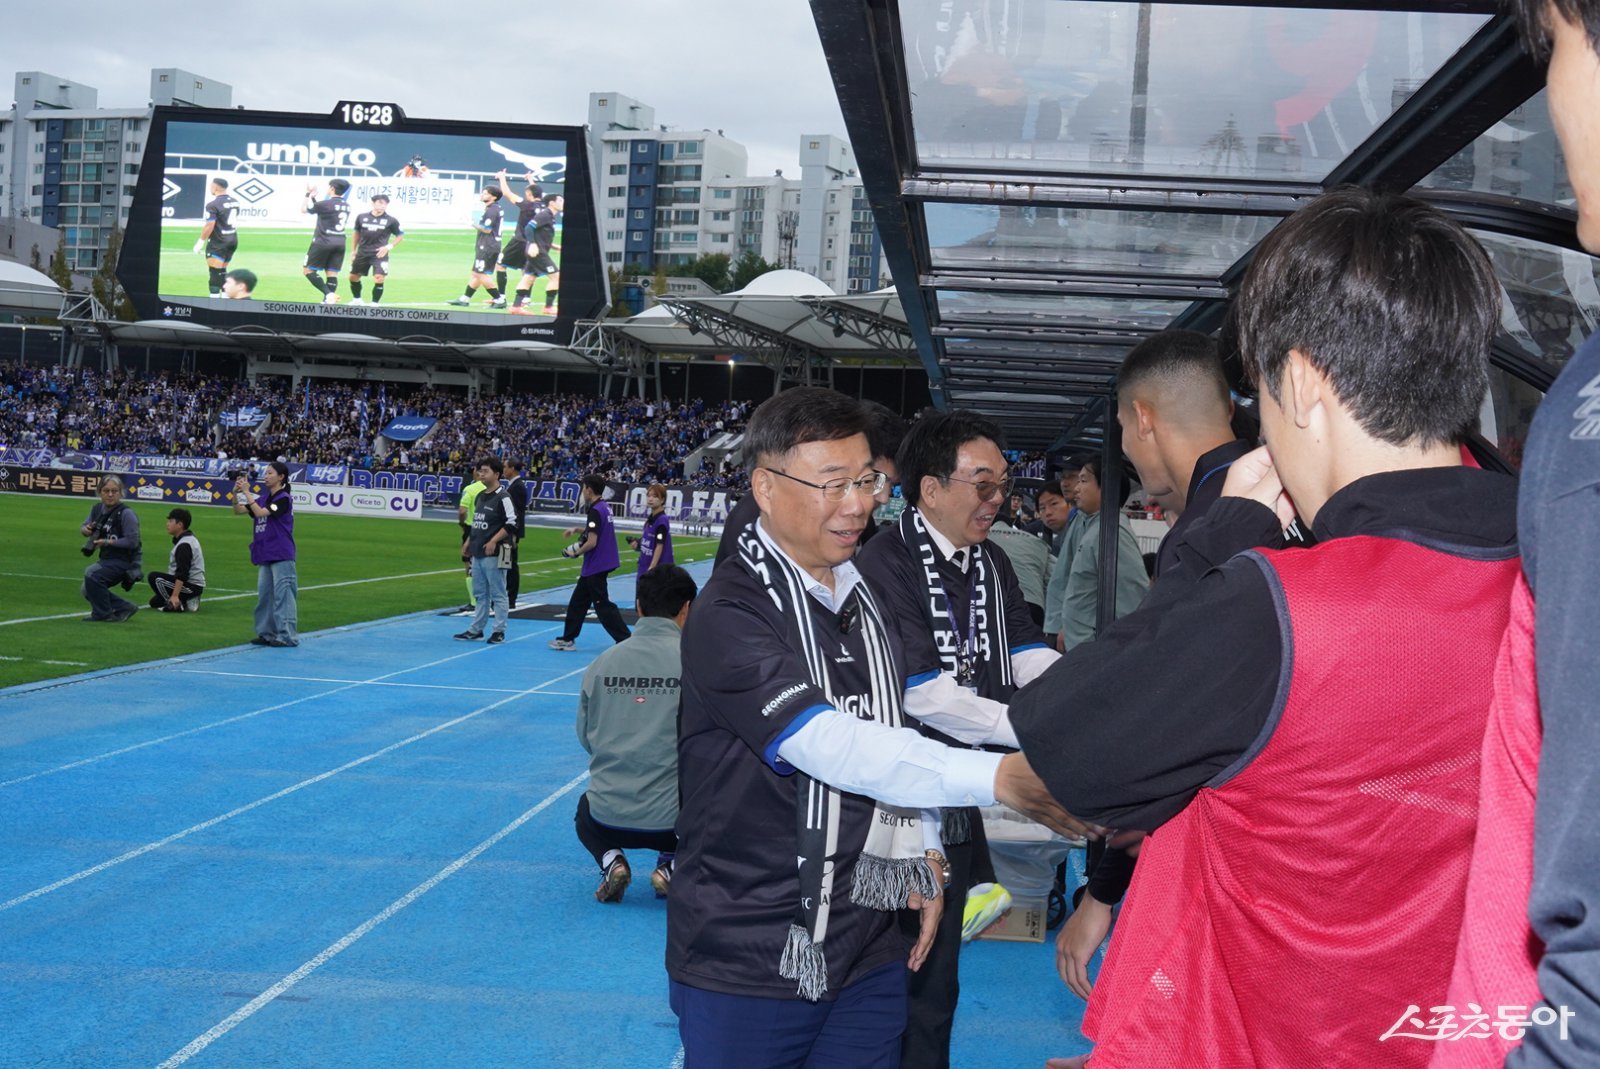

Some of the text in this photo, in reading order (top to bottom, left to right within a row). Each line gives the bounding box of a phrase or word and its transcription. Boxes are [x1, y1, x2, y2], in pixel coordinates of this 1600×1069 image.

[342, 104, 392, 125] 16:28
[247, 140, 376, 167] umbro
[396, 185, 453, 204] 재활의학과
[264, 302, 450, 321] SEONGNAM TANCHEON SPORTS COMPLEX
[71, 475, 101, 493] 클리
[316, 492, 344, 507] CU
[356, 498, 372, 506] Nice
[390, 496, 418, 512] CU
[968, 605, 976, 628] LEAGUE
[604, 676, 681, 688] UMBRO
[606, 688, 676, 696] SPORTSWEAR
[761, 682, 809, 717] SEONGNAM
